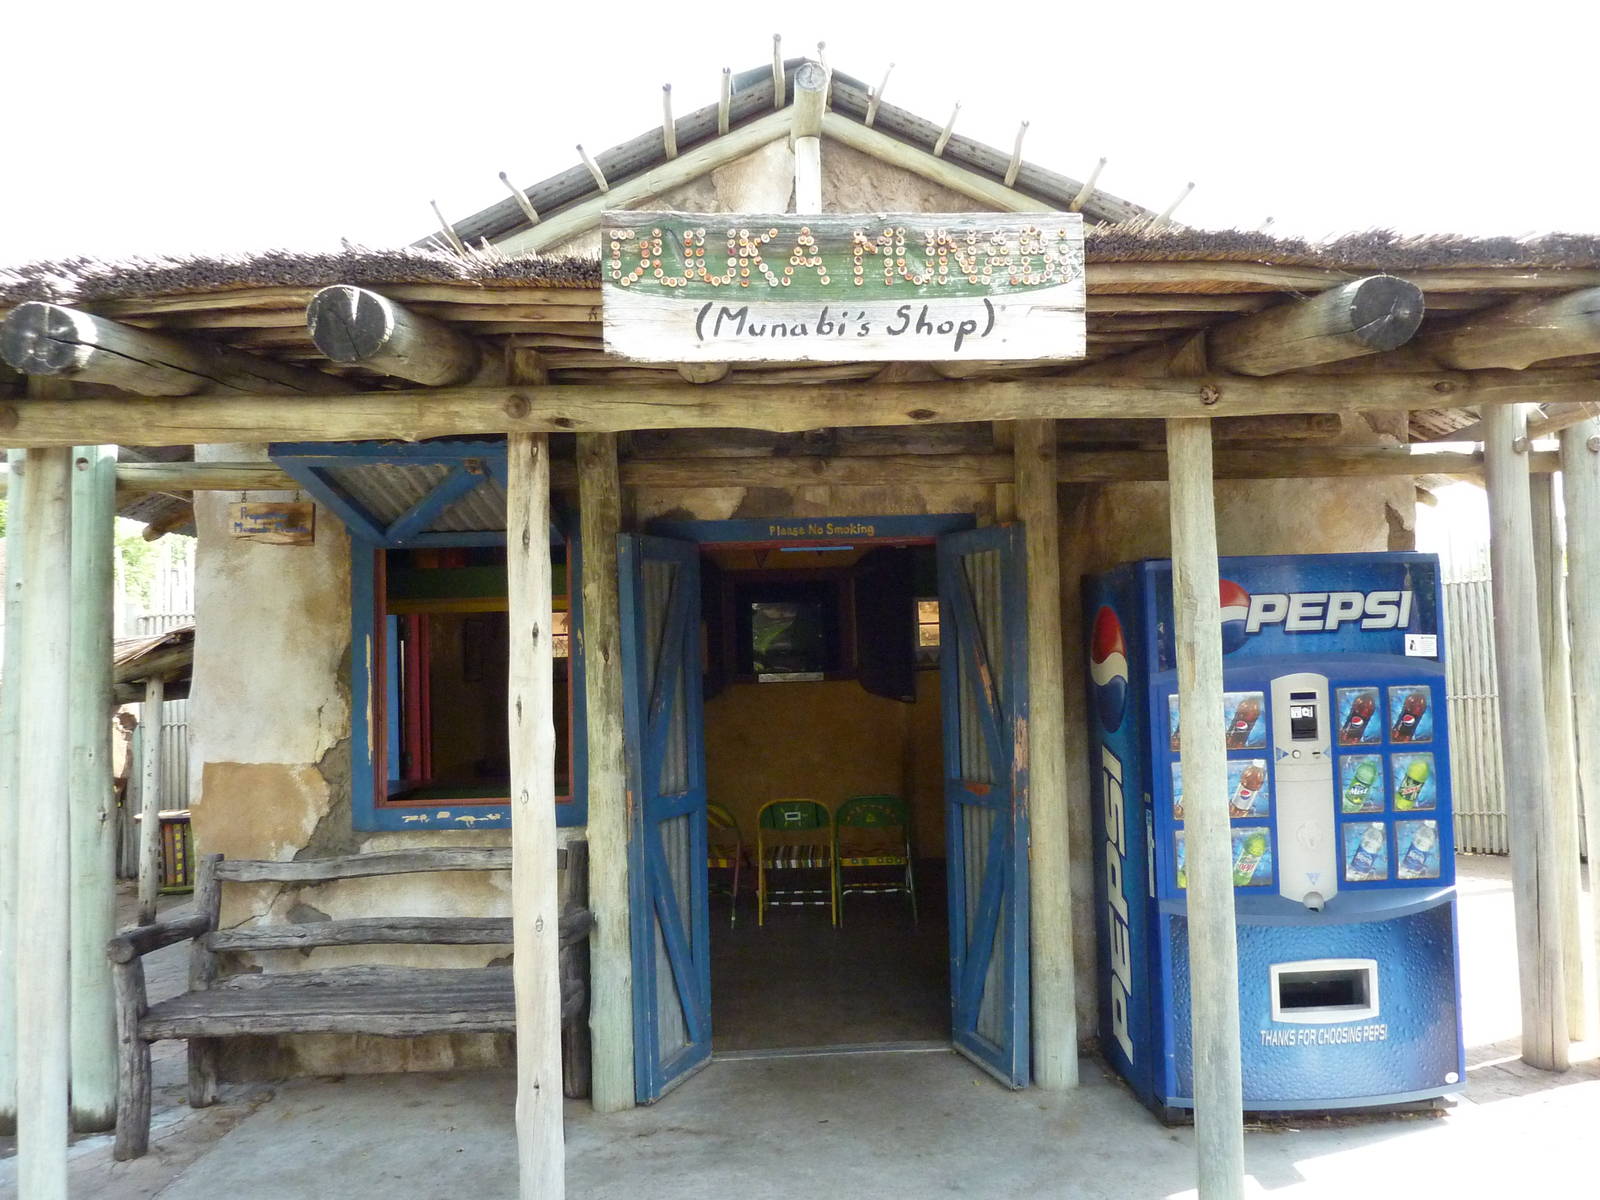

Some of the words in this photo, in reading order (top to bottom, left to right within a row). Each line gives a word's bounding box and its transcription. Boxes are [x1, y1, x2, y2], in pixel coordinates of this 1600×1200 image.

[609, 226, 831, 288] DUUKA
[853, 226, 1073, 287] MUNABI
[695, 301, 870, 341] (Munabi's
[886, 298, 995, 352] Shop)
[768, 525, 806, 537] Please
[808, 523, 823, 536] No
[826, 522, 875, 537] Smoking
[1245, 590, 1413, 633] PEPSI
[1101, 744, 1134, 1066] PEPSI
[1260, 1029, 1296, 1047] THANKS
[1297, 1028, 1317, 1046] FOR
[1318, 1025, 1361, 1045] CHOOSING
[1363, 1023, 1388, 1041] PEPSI
